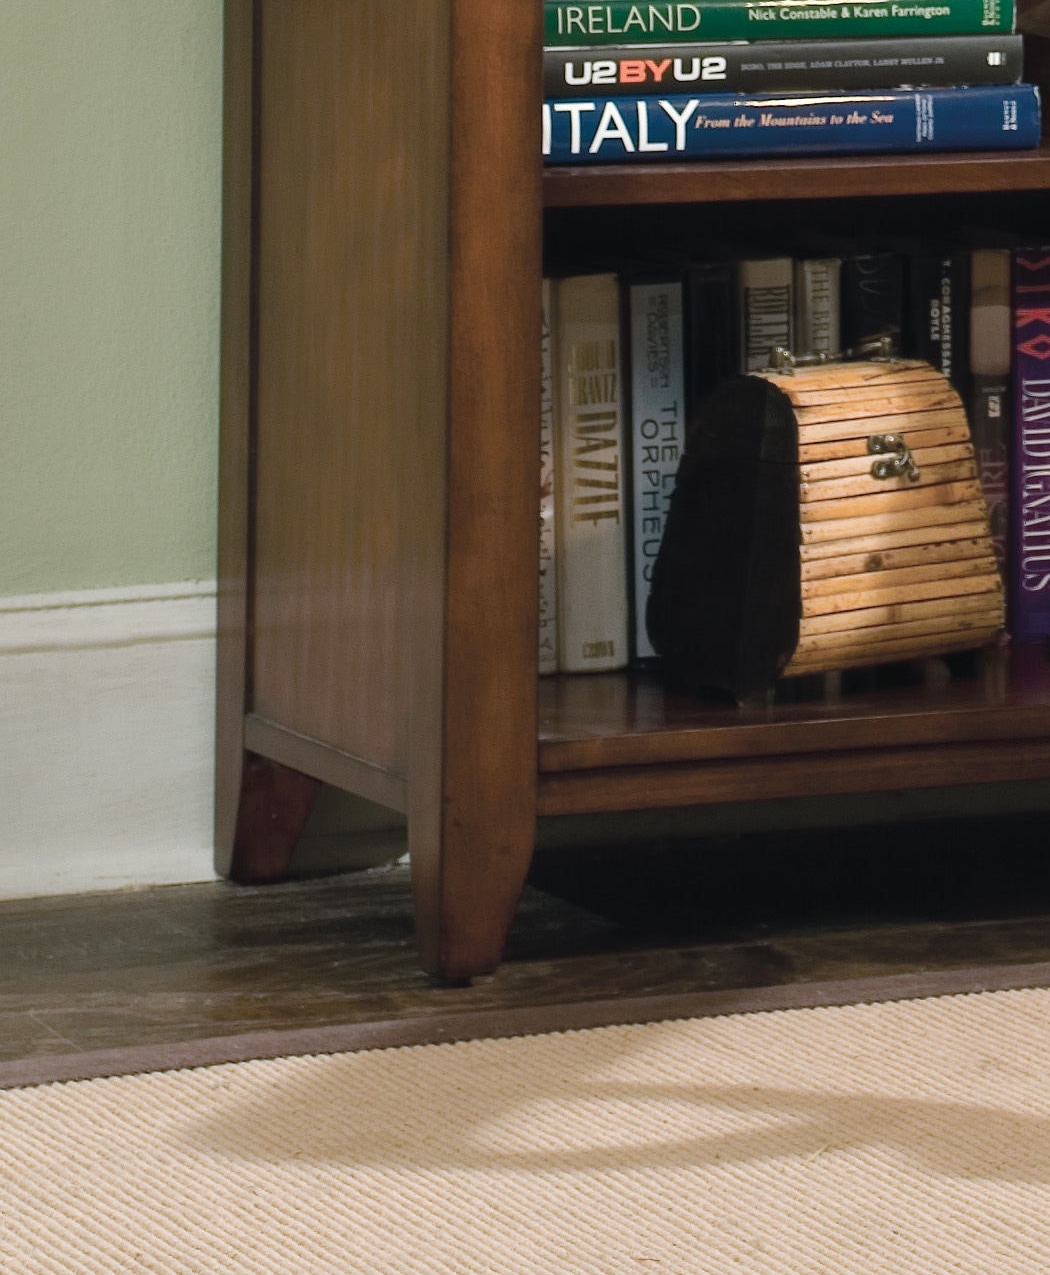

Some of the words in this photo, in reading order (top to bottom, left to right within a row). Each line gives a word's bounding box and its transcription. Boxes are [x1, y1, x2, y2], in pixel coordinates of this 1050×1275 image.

[557, 3, 701, 34] IRELAND
[749, 8, 776, 21] Nick
[780, 7, 838, 21] Constable
[841, 7, 850, 18] &
[854, 6, 889, 18] Karen
[891, 4, 950, 19] Farrington
[542, 99, 700, 155] ITALY
[696, 115, 730, 129] From
[734, 113, 756, 127] the
[759, 112, 827, 127] Mountains
[830, 113, 843, 125] to
[846, 111, 867, 124] the
[869, 110, 894, 124] Sea
[811, 268, 829, 304] THE
[661, 400, 680, 462] THE
[571, 411, 620, 528] DAZZLE
